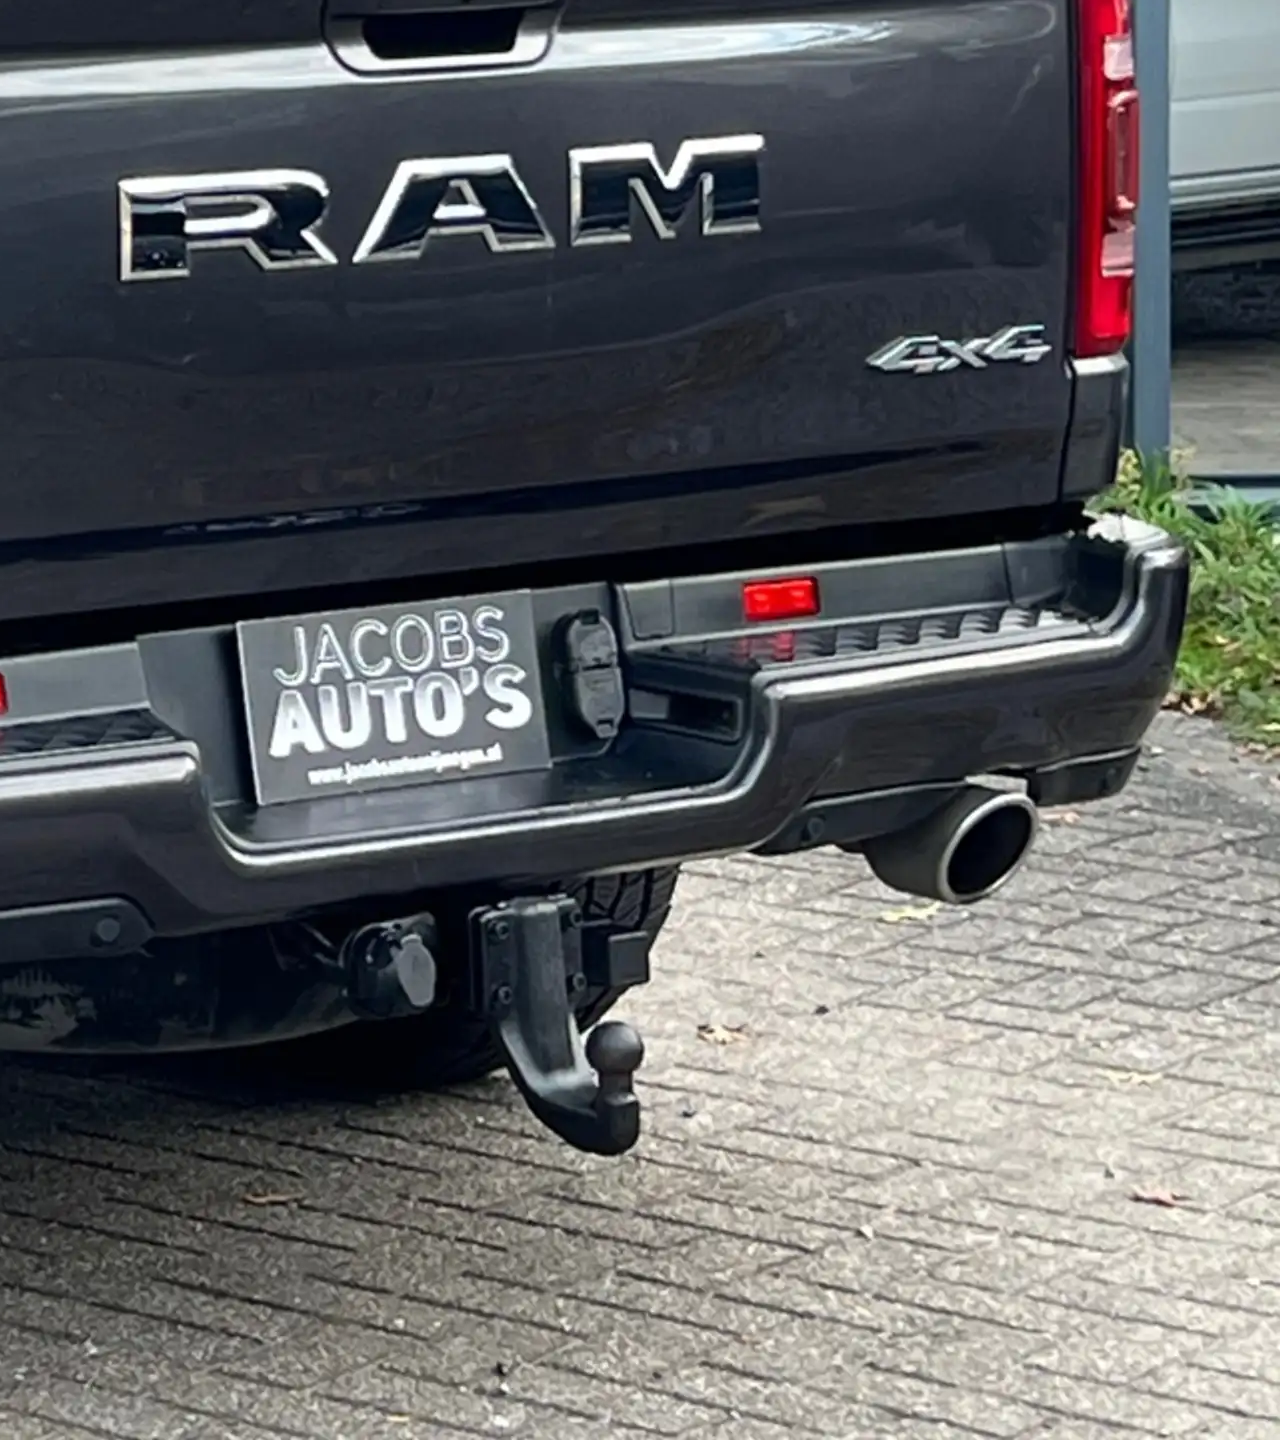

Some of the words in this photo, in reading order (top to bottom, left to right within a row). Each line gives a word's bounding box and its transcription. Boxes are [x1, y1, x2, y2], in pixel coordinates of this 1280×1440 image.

[117, 133, 767, 282] RAM
[273, 604, 511, 688] JACOBS
[268, 663, 534, 758] AUTO'S
